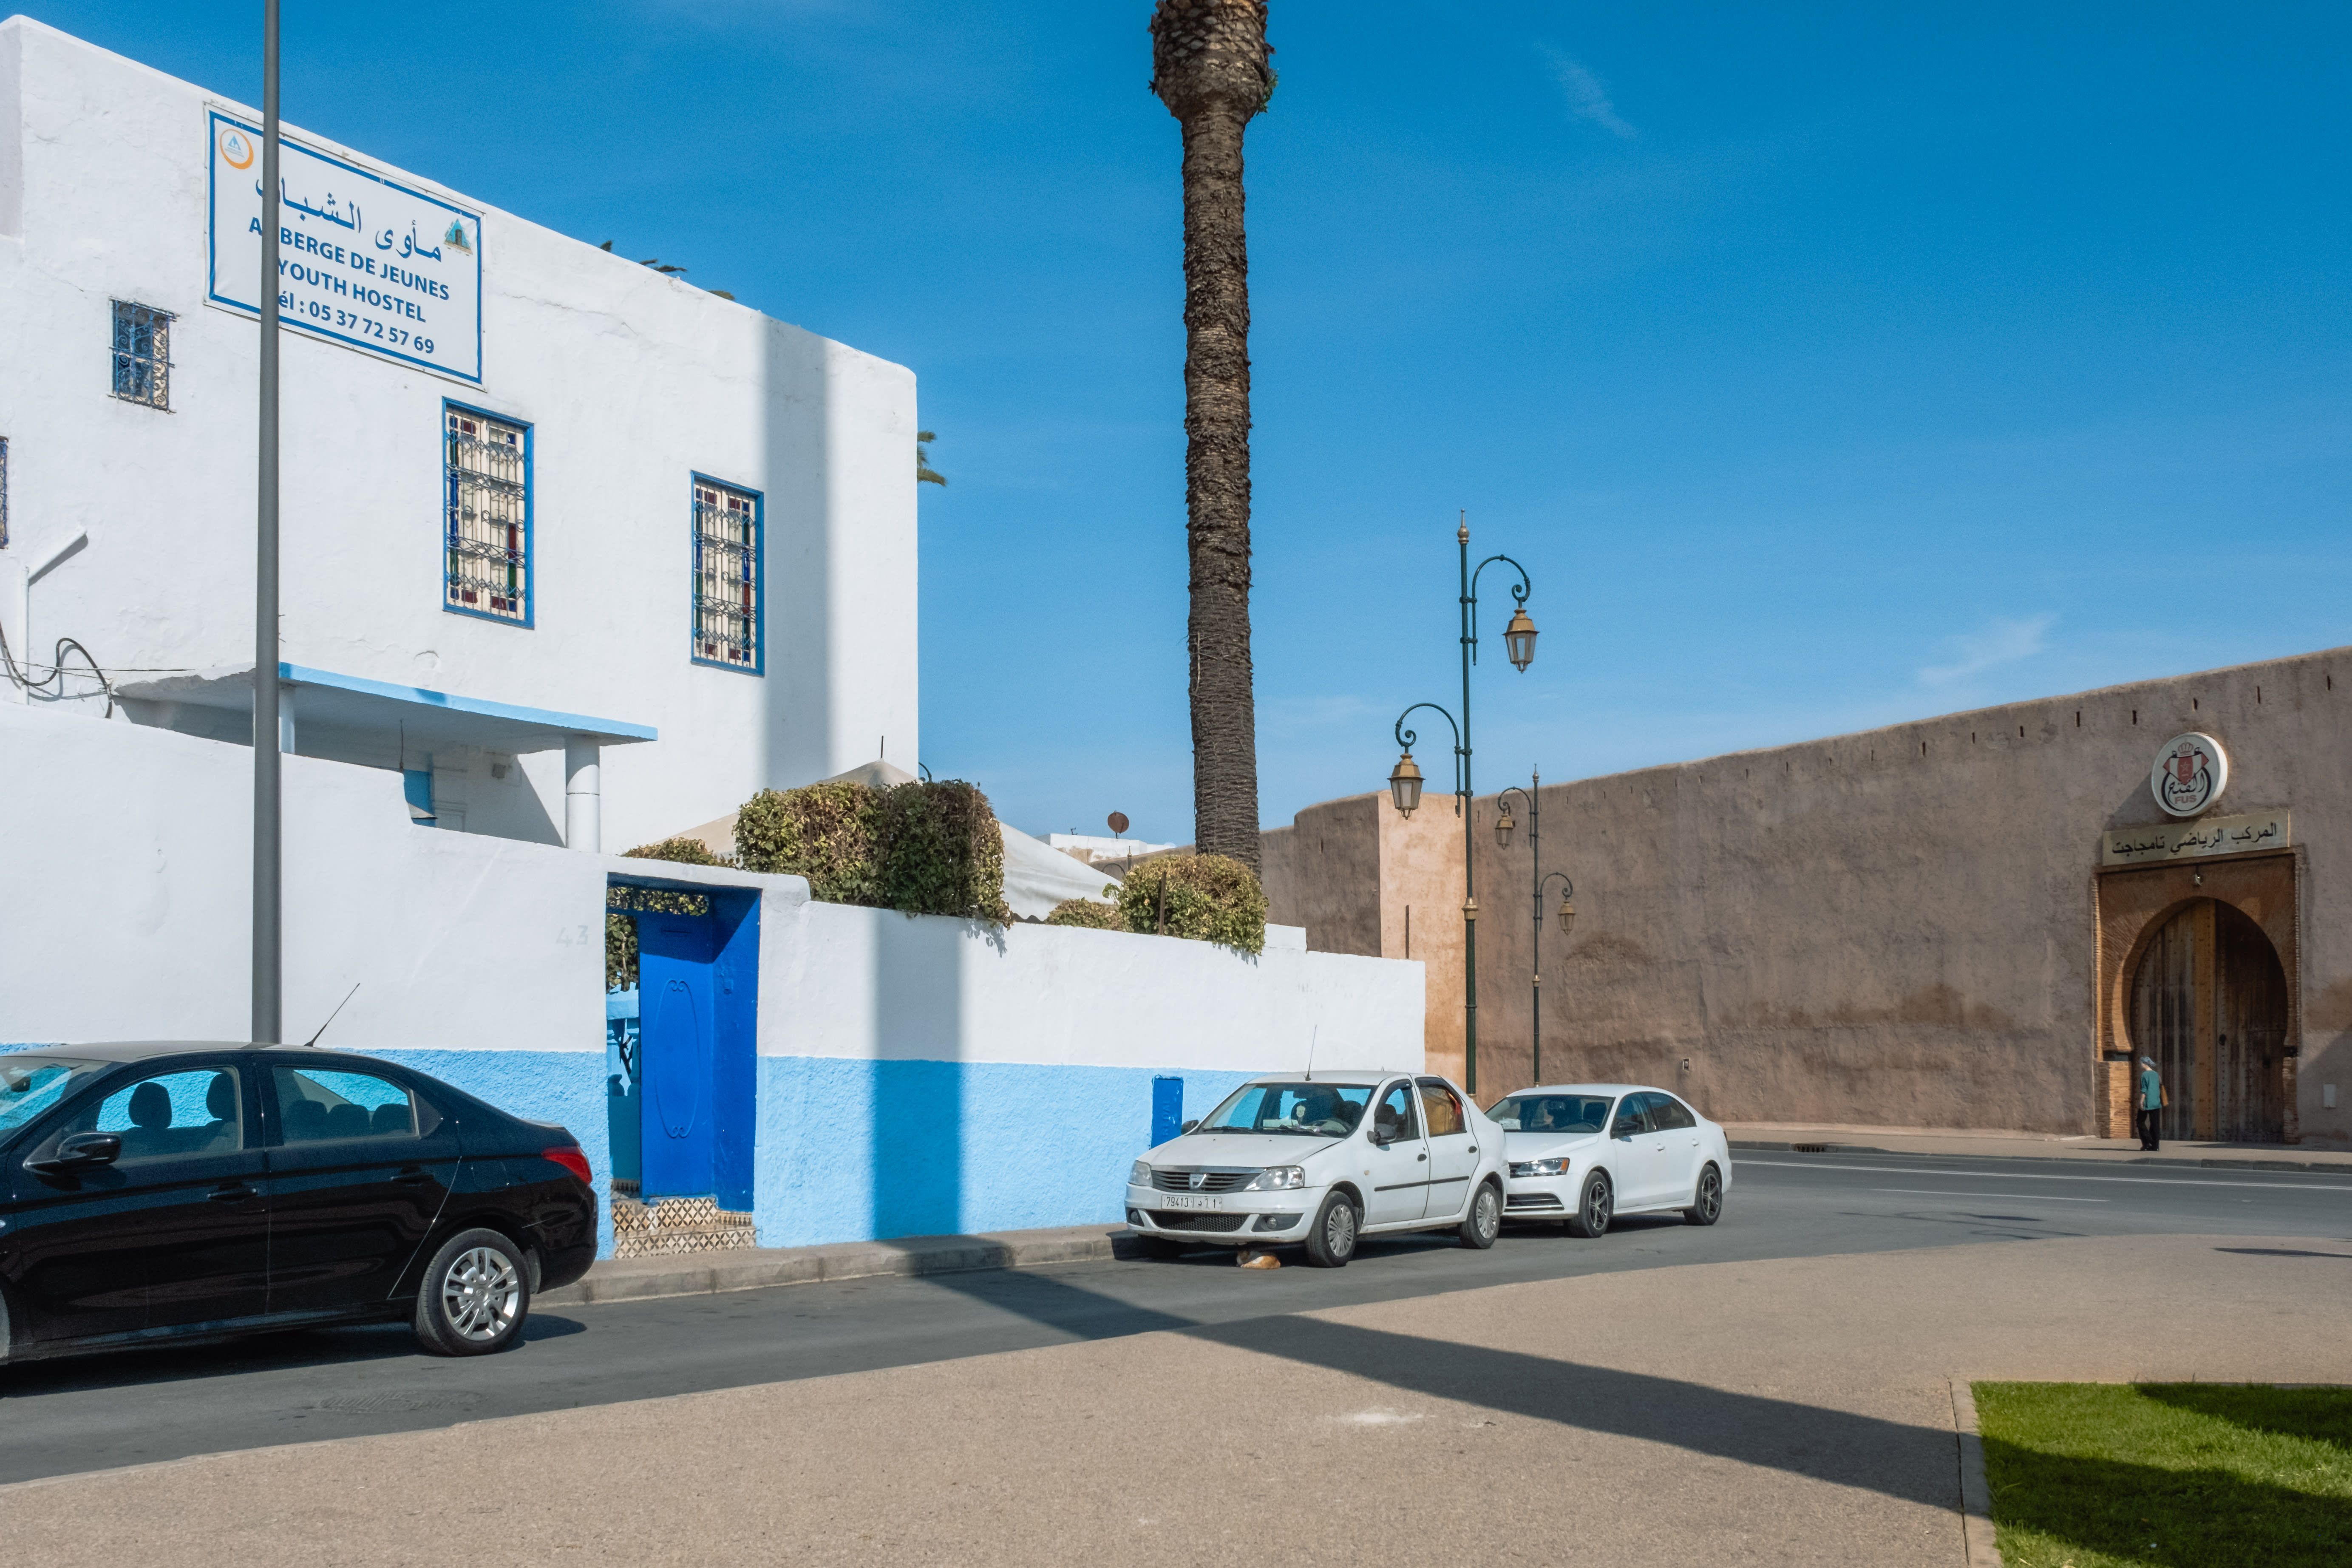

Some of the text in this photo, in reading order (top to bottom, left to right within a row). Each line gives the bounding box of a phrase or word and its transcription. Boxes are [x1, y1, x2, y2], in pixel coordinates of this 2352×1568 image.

[255, 177, 442, 263] مأوى الشبا
[249, 217, 449, 301] ABERGE DE JEUNES
[278, 257, 426, 323] YOUTH HOSTEL
[278, 290, 294, 310] él
[309, 301, 331, 321] 05
[337, 309, 358, 329] 37
[363, 318, 384, 339] 72
[389, 326, 409, 346] 57
[414, 336, 434, 354] 69
[2175, 794, 2197, 804] FUS
[2170, 828, 2223, 853] الرياضي
[2231, 822, 2277, 843] المركب
[1166, 1197, 1189, 1208] 79413
